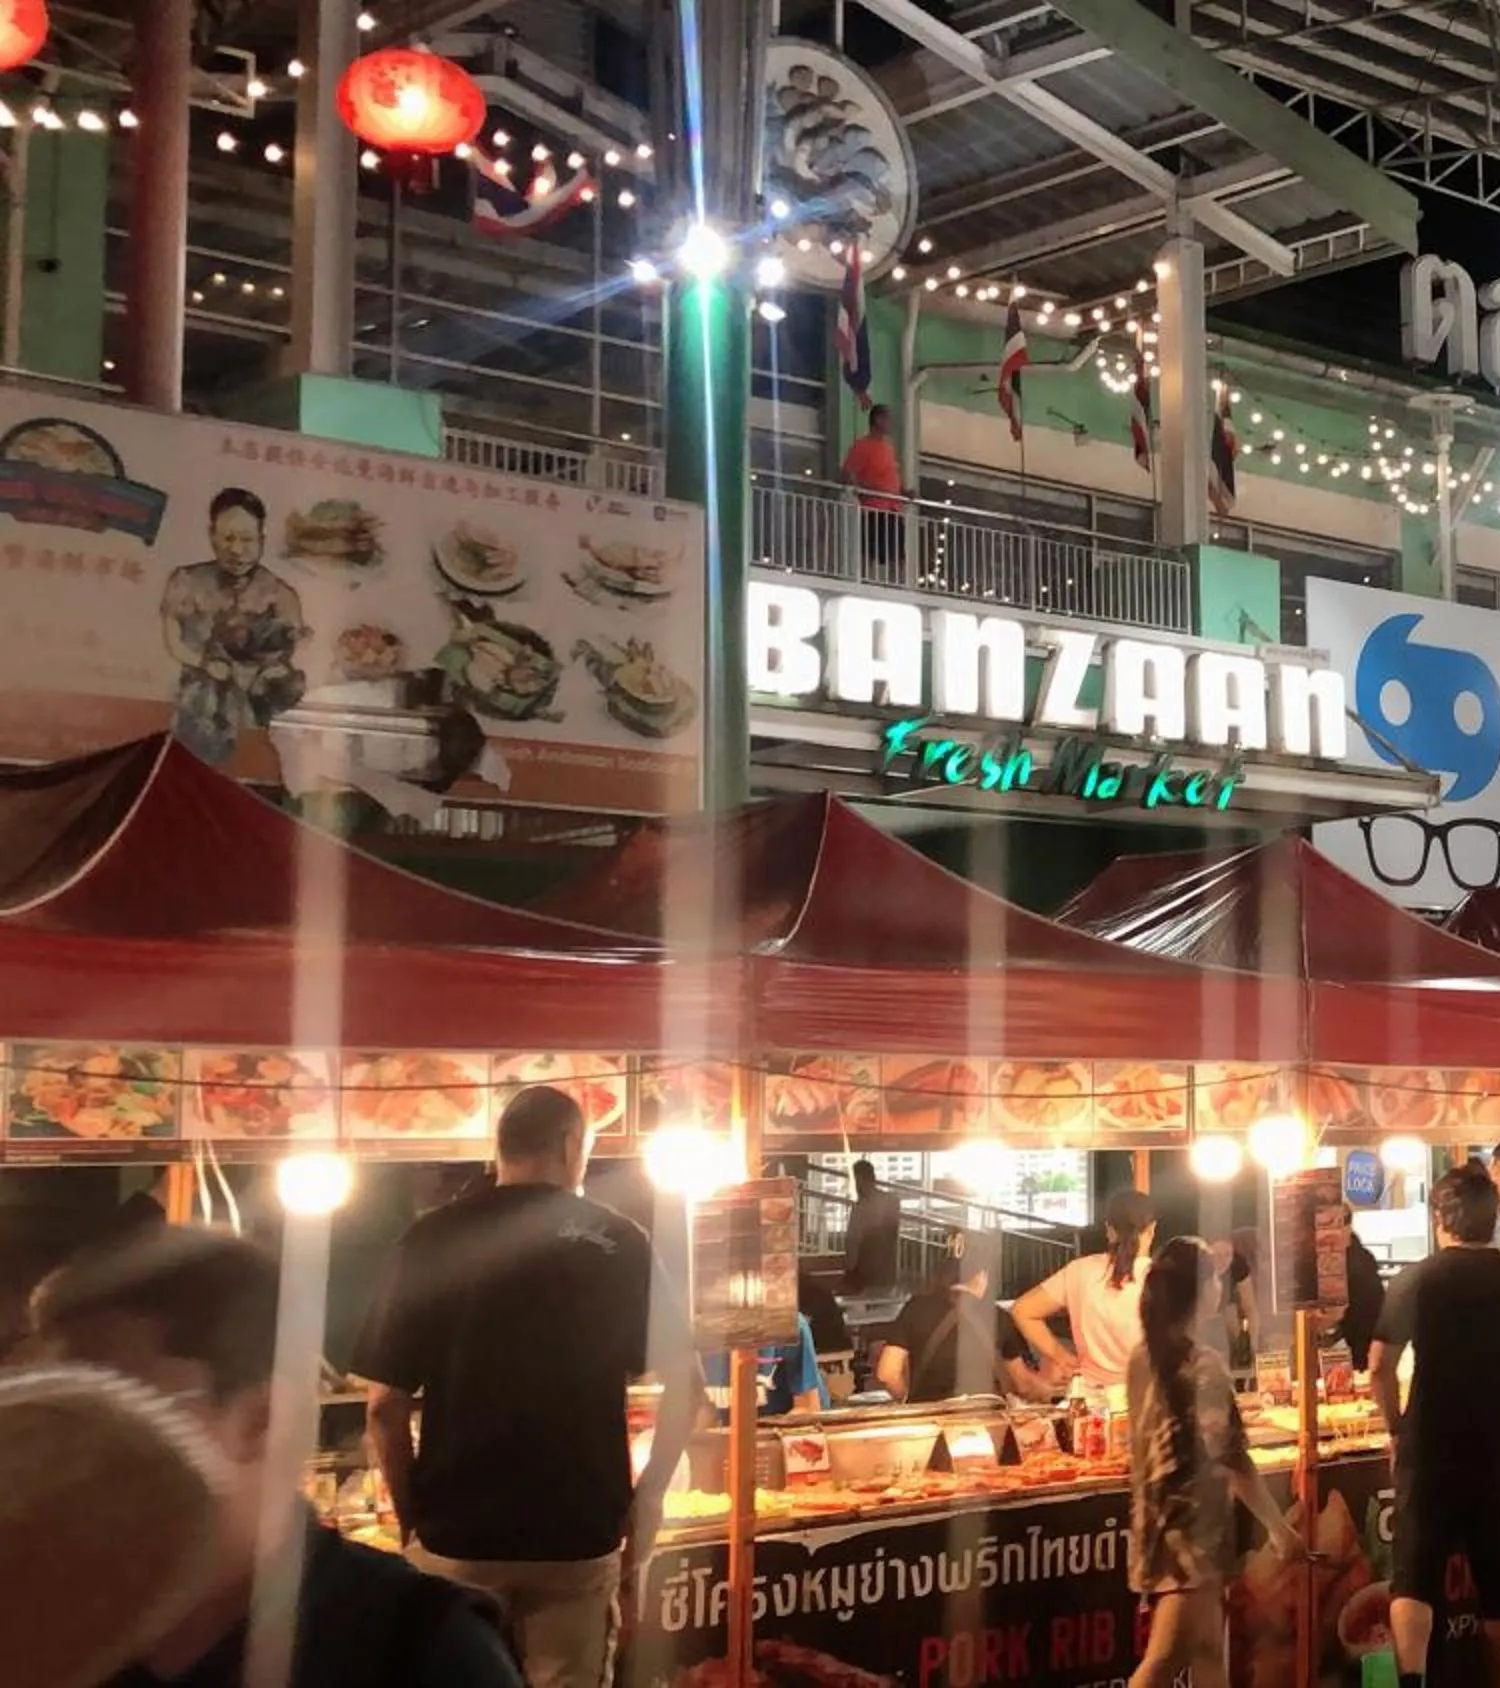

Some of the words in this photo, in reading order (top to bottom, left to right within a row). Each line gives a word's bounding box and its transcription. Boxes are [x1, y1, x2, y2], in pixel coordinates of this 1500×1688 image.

[747, 581, 1348, 760] BANZAAN
[881, 714, 1034, 794] Fresh
[1050, 736, 1247, 812] Market
[918, 1620, 1033, 1688] PORK
[1051, 1608, 1118, 1669] RIB
